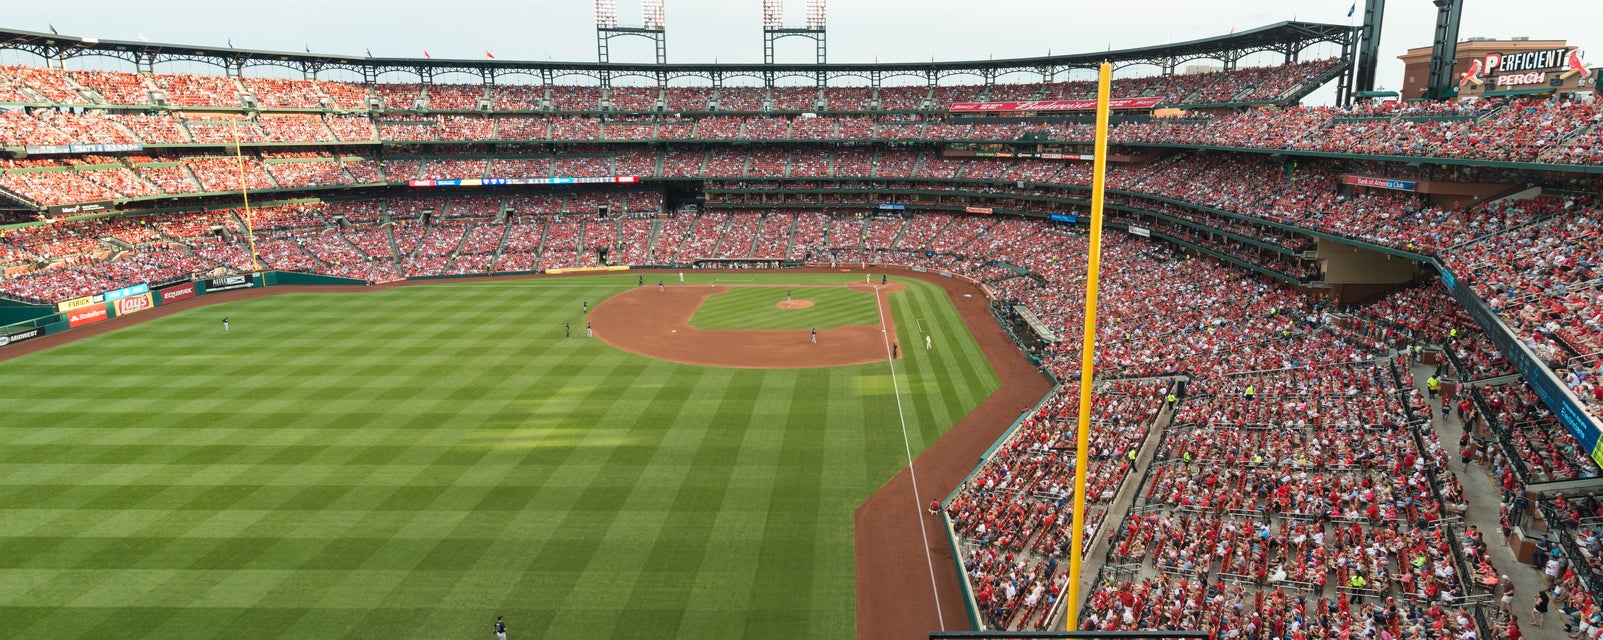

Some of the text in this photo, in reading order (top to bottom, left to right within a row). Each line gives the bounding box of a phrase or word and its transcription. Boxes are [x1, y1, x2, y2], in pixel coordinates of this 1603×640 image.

[1483, 49, 1566, 76] PERFICIENT
[1498, 72, 1546, 86] PERCH
[1015, 101, 1097, 110] Budweiser
[1374, 179, 1392, 187] America
[164, 287, 192, 299] EQUIFAX
[68, 298, 90, 308] FABICK
[10, 330, 38, 342] MIDWEST
